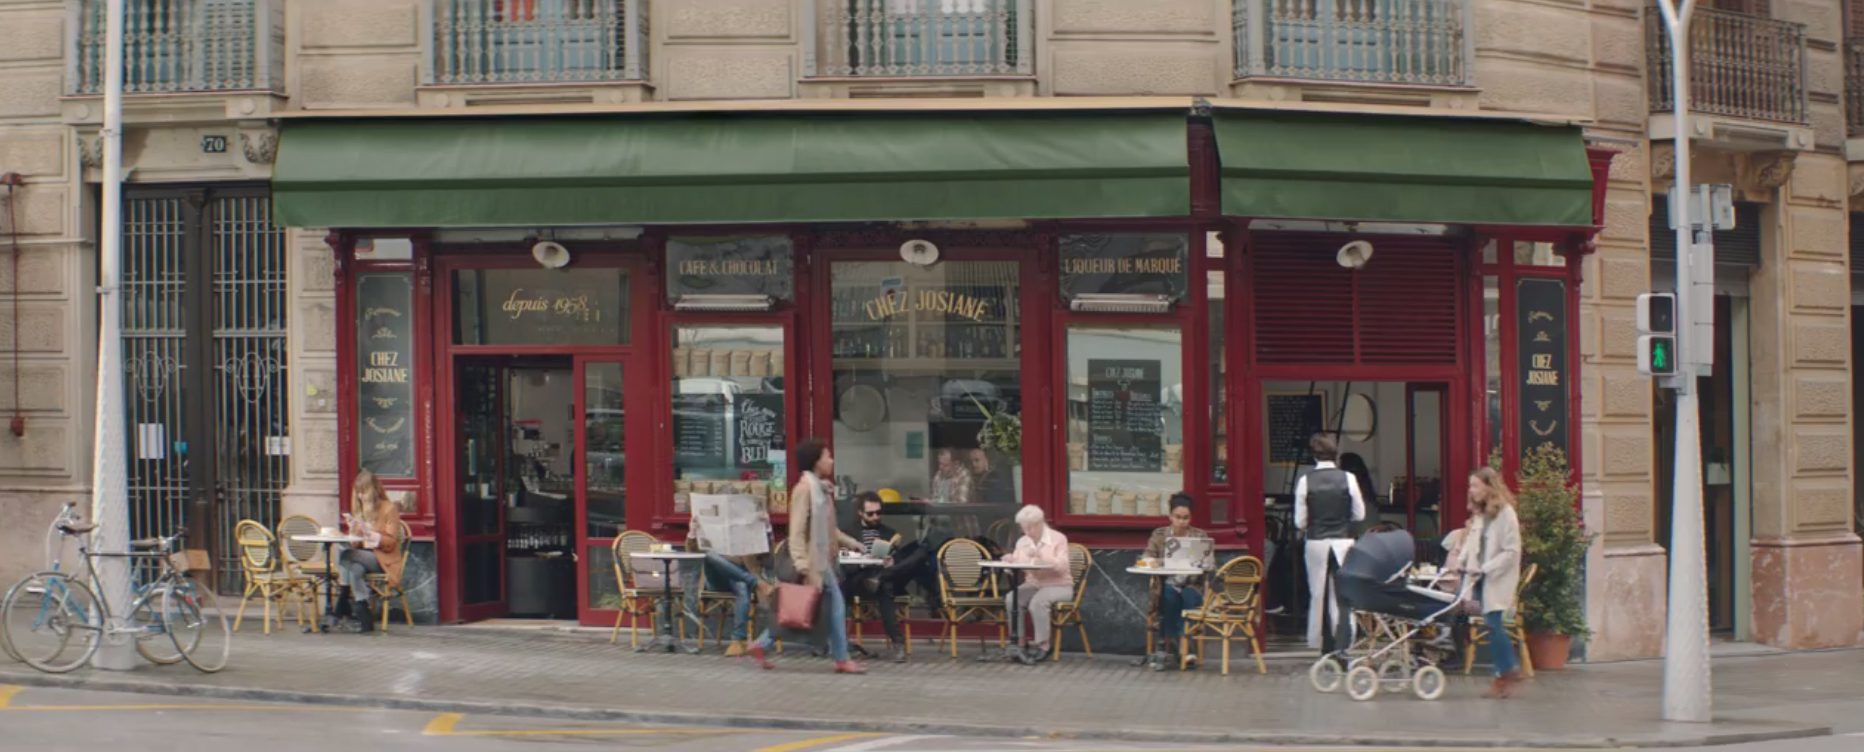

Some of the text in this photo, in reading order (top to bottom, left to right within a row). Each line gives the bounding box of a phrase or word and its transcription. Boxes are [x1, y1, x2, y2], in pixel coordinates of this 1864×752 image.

[205, 137, 225, 151] 70
[709, 260, 721, 275] &
[721, 259, 778, 275] CHOCOLAT
[1065, 257, 1182, 274] LIQUEUR DE MARQUE
[502, 288, 549, 320] depuis
[865, 290, 988, 322] CHEZ JOSIANE
[370, 351, 399, 367] CHEZ
[1532, 353, 1553, 369] CHEZ
[361, 368, 409, 382] JOSIANE
[1526, 370, 1559, 385] JOSIANE
